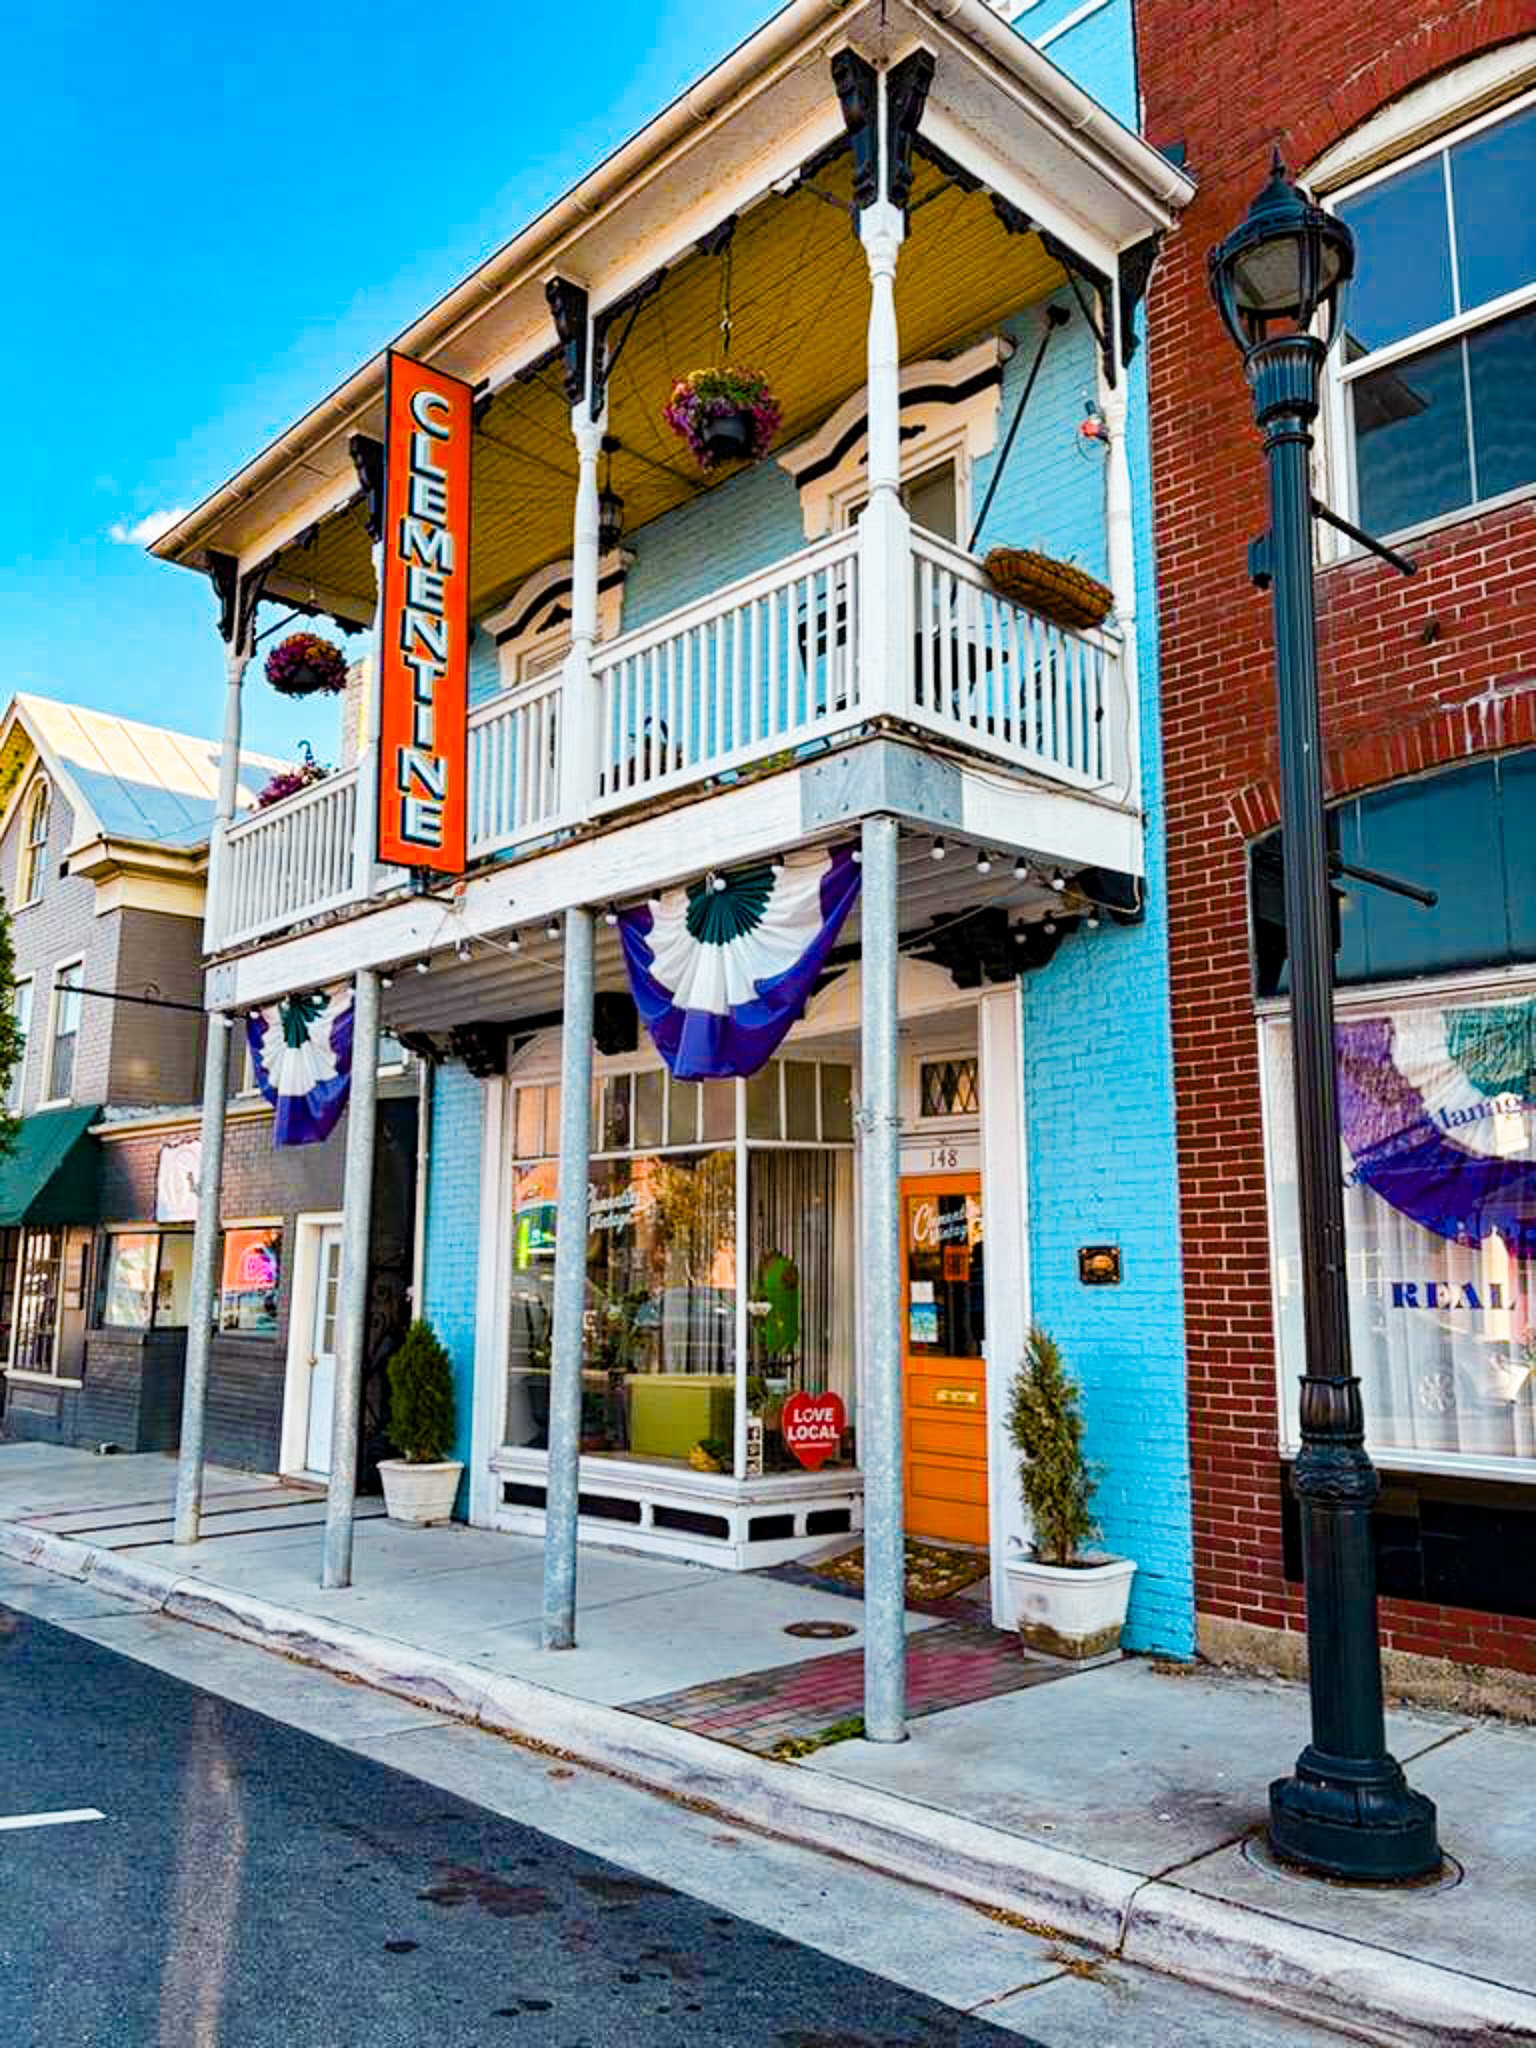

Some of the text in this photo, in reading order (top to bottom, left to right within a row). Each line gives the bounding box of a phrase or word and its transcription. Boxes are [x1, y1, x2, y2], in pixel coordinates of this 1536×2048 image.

[399, 389, 453, 848] CLEMENTINE
[929, 1148, 958, 1168] 148
[1391, 1281, 1516, 1310] REAL
[793, 1407, 834, 1423] LOVE
[787, 1425, 840, 1441] LOCAL
